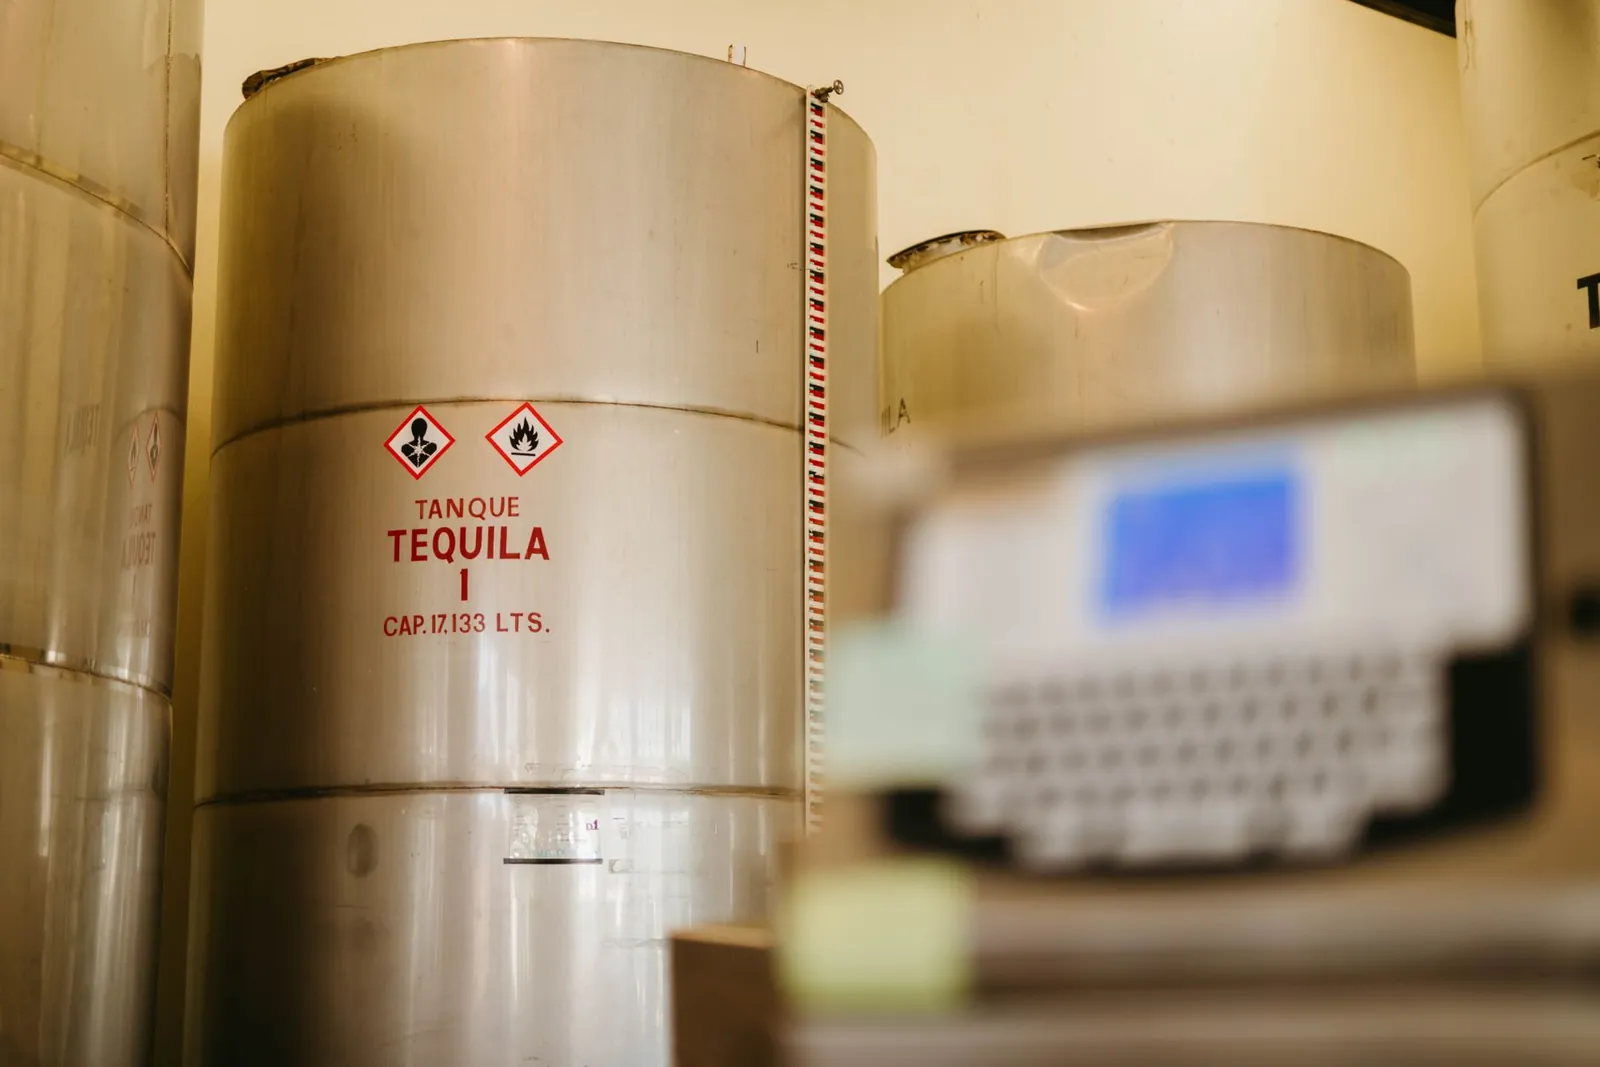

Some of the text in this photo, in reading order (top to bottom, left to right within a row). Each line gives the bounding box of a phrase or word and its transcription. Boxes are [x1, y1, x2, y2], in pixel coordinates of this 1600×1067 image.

[415, 496, 520, 520] TANQUE
[387, 526, 550, 564] TEQUILA
[460, 568, 469, 601] 1
[495, 612, 551, 633] LTS.
